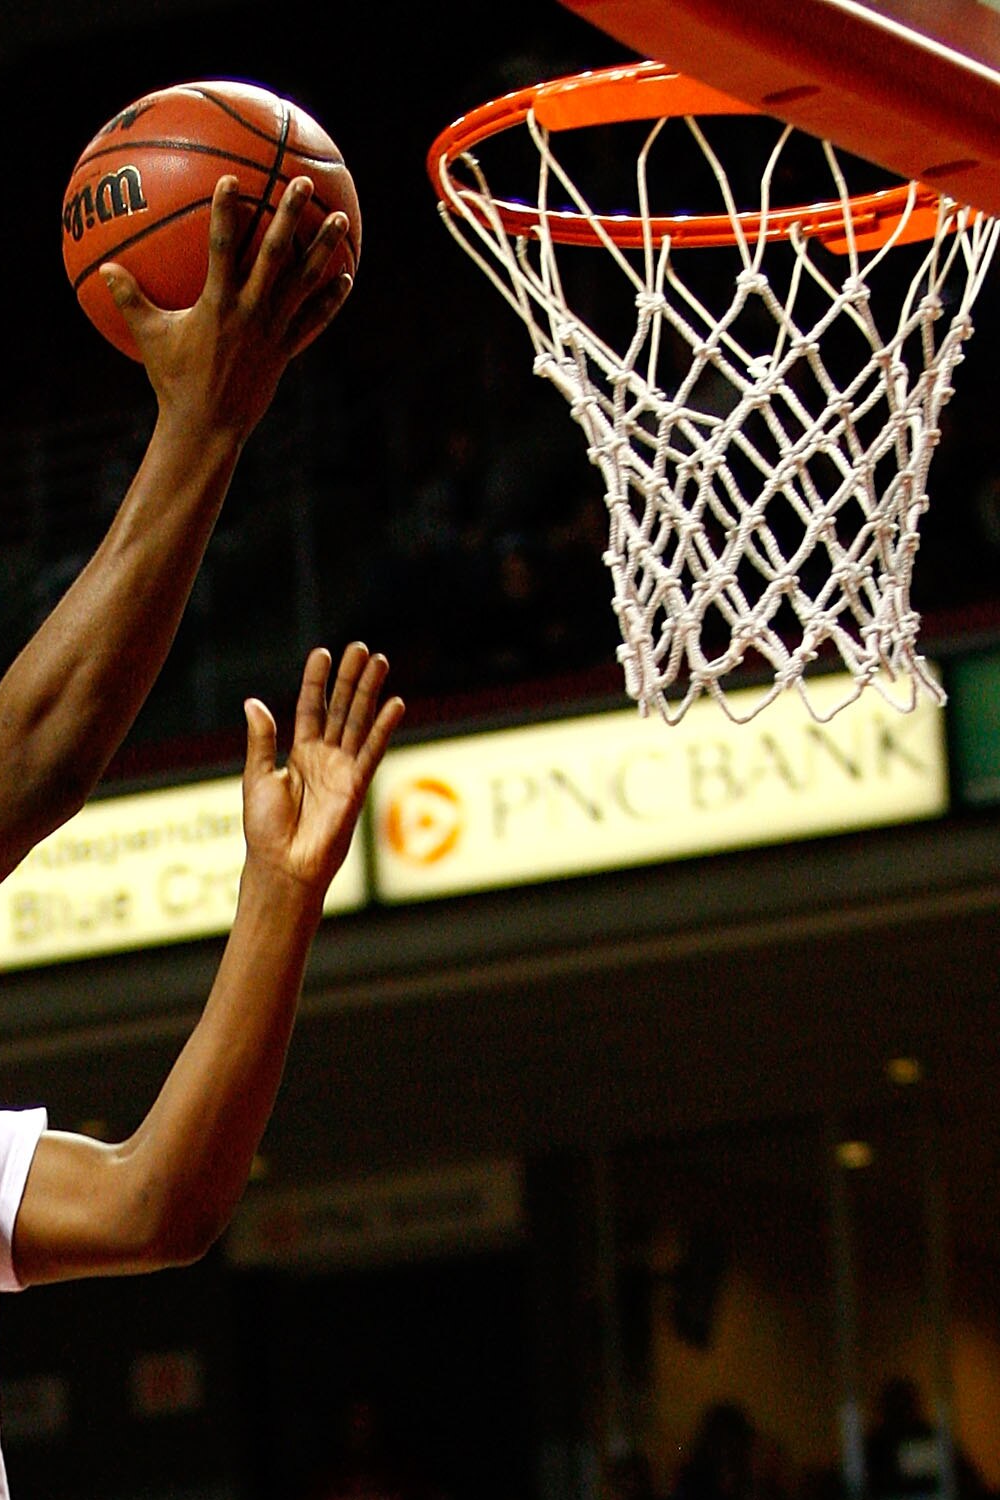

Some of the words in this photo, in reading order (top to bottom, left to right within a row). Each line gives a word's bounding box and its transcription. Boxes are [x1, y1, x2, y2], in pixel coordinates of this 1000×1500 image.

[486, 745, 666, 842] PNC
[682, 708, 932, 812] BANK
[10, 880, 132, 944] Blue
